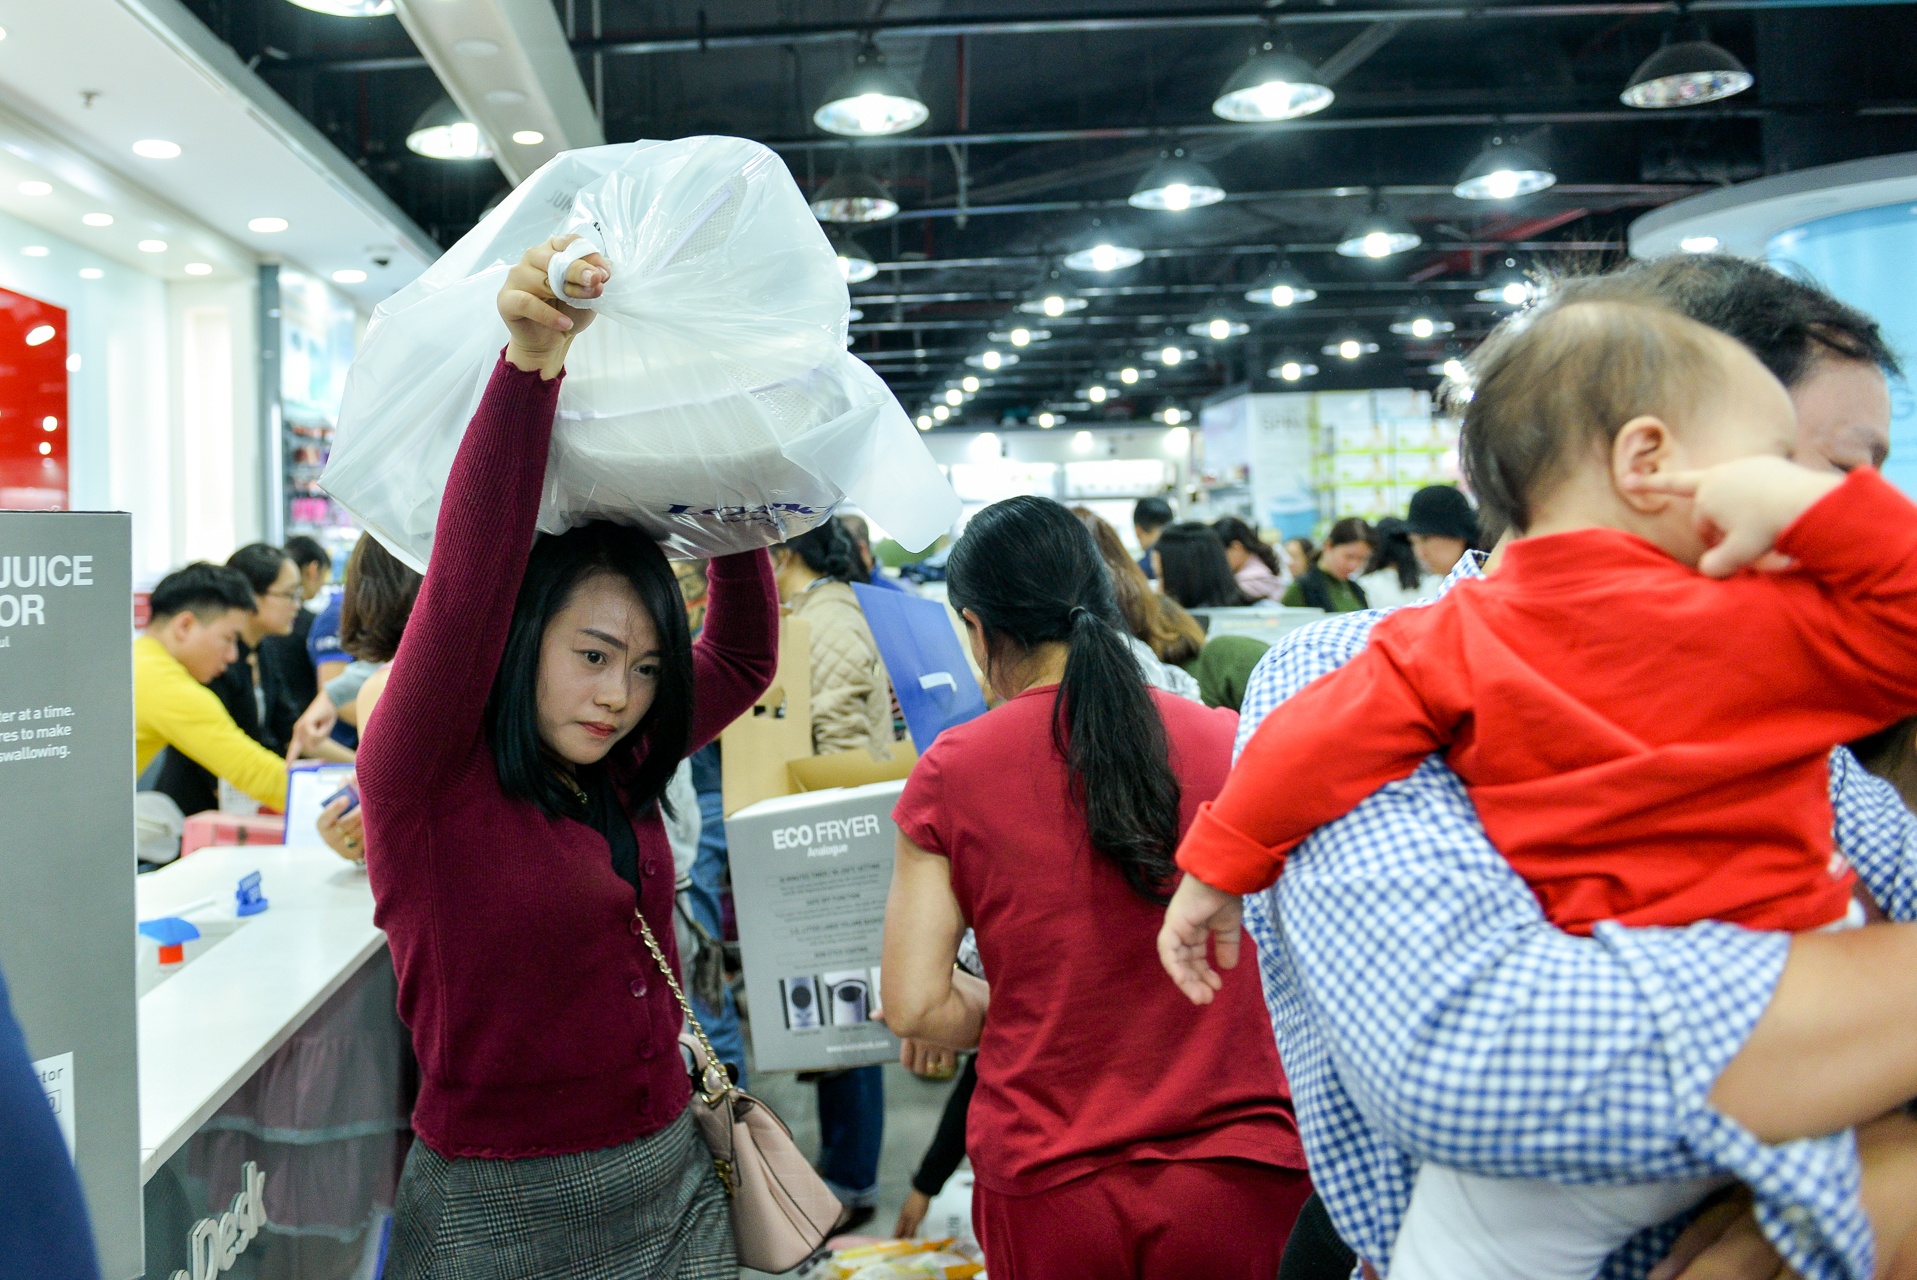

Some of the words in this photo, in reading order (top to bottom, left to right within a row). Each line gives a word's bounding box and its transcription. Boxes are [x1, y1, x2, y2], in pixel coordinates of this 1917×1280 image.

[0, 555, 94, 589] JUICE
[18, 708, 31, 721] at
[33, 709, 42, 720] a
[43, 705, 75, 719] time.
[20, 728, 35, 741] to
[36, 724, 72, 739] make
[772, 824, 814, 850] ECO
[815, 814, 880, 843] FRYER
[807, 843, 849, 858] Analogue
[37, 1067, 64, 1083] tor
